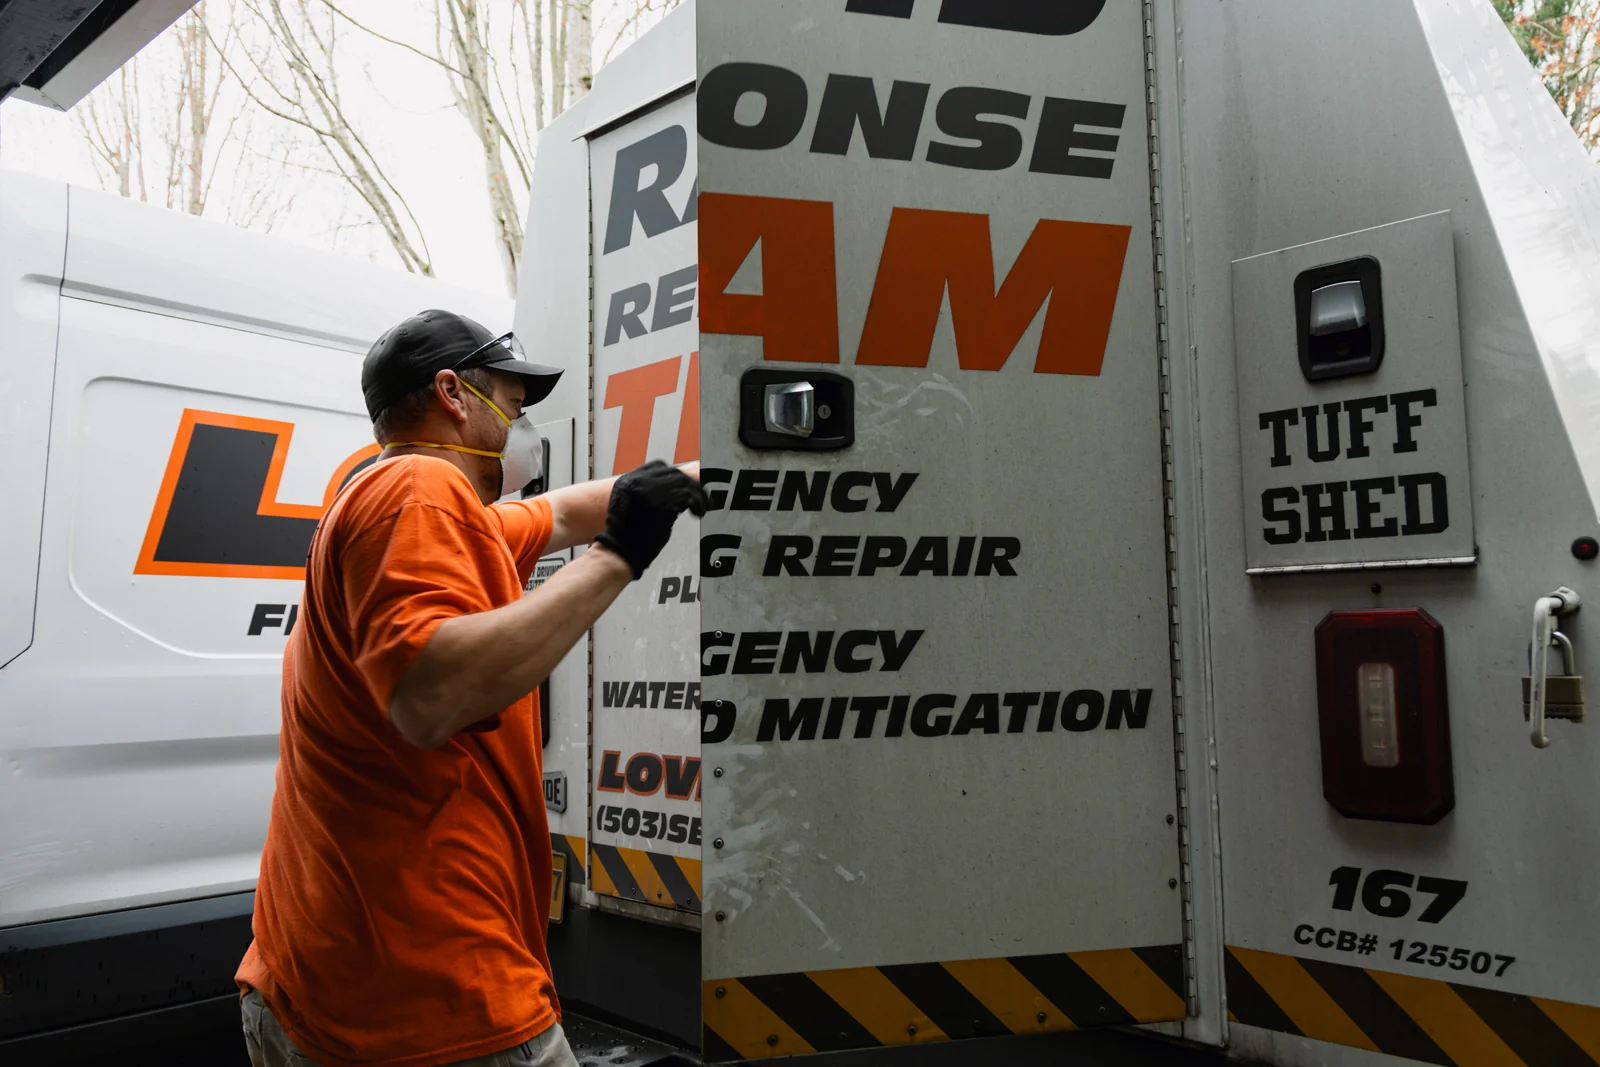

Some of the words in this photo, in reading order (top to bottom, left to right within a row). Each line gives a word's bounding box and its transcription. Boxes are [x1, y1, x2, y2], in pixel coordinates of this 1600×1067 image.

[697, 62, 1127, 179] ONSE
[603, 125, 697, 255] R
[697, 192, 1132, 376] AM
[1259, 388, 1437, 467] TUFF
[133, 408, 384, 580] L
[700, 468, 919, 513] GENCY
[1260, 472, 1449, 545] SHED
[762, 535, 1021, 576] REPAIR
[658, 576, 700, 604] PL
[701, 630, 925, 676] GENCY
[602, 681, 701, 709] WATER
[756, 688, 1153, 742] MITIGATION
[597, 750, 701, 801] LOV
[1328, 865, 1468, 924] 167
[1293, 924, 1378, 956] CCB#
[1389, 939, 1516, 977] 125507
